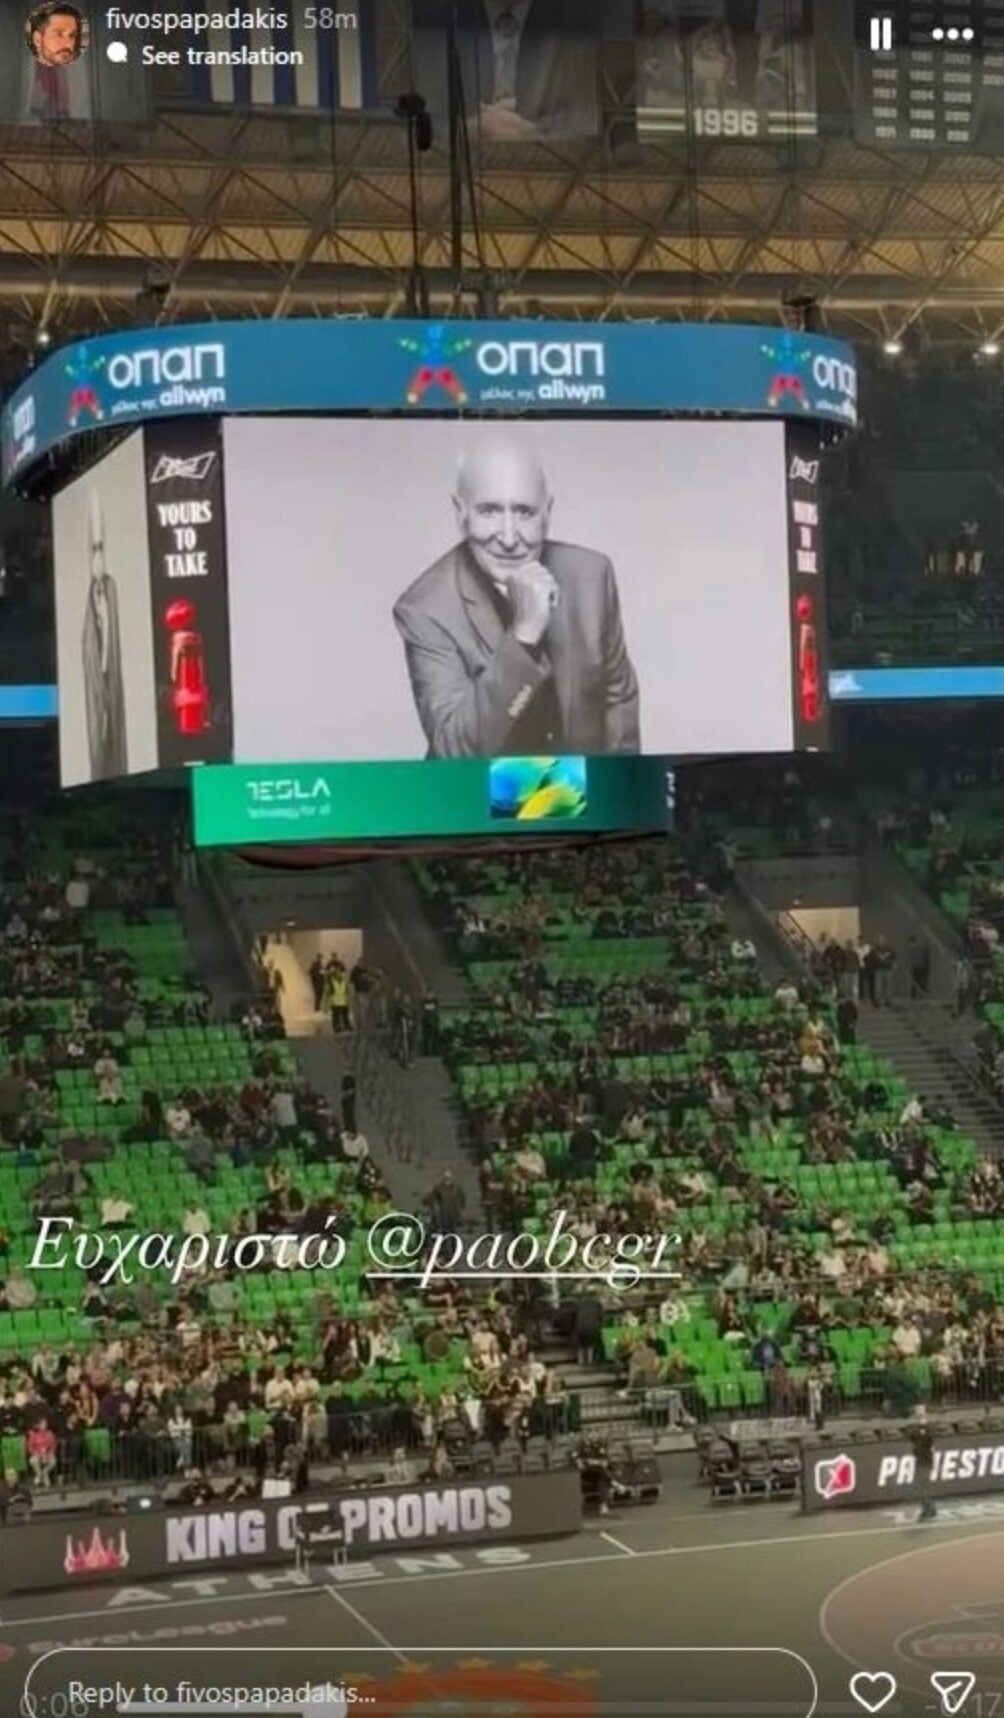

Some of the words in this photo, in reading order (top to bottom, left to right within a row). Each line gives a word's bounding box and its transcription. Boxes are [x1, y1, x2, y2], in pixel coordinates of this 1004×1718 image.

[695, 108, 758, 137] 1996
[160, 384, 226, 408] allwyn
[538, 379, 605, 404] allwyn
[157, 500, 213, 527] YOURS
[173, 527, 197, 551] TO
[164, 552, 208, 578] TAKE
[245, 777, 332, 801] TESLA
[166, 1509, 266, 1563] KING
[277, 1503, 332, 1551] O
[340, 1485, 513, 1544] PROMOS
[107, 1546, 533, 1608] ATHENS
